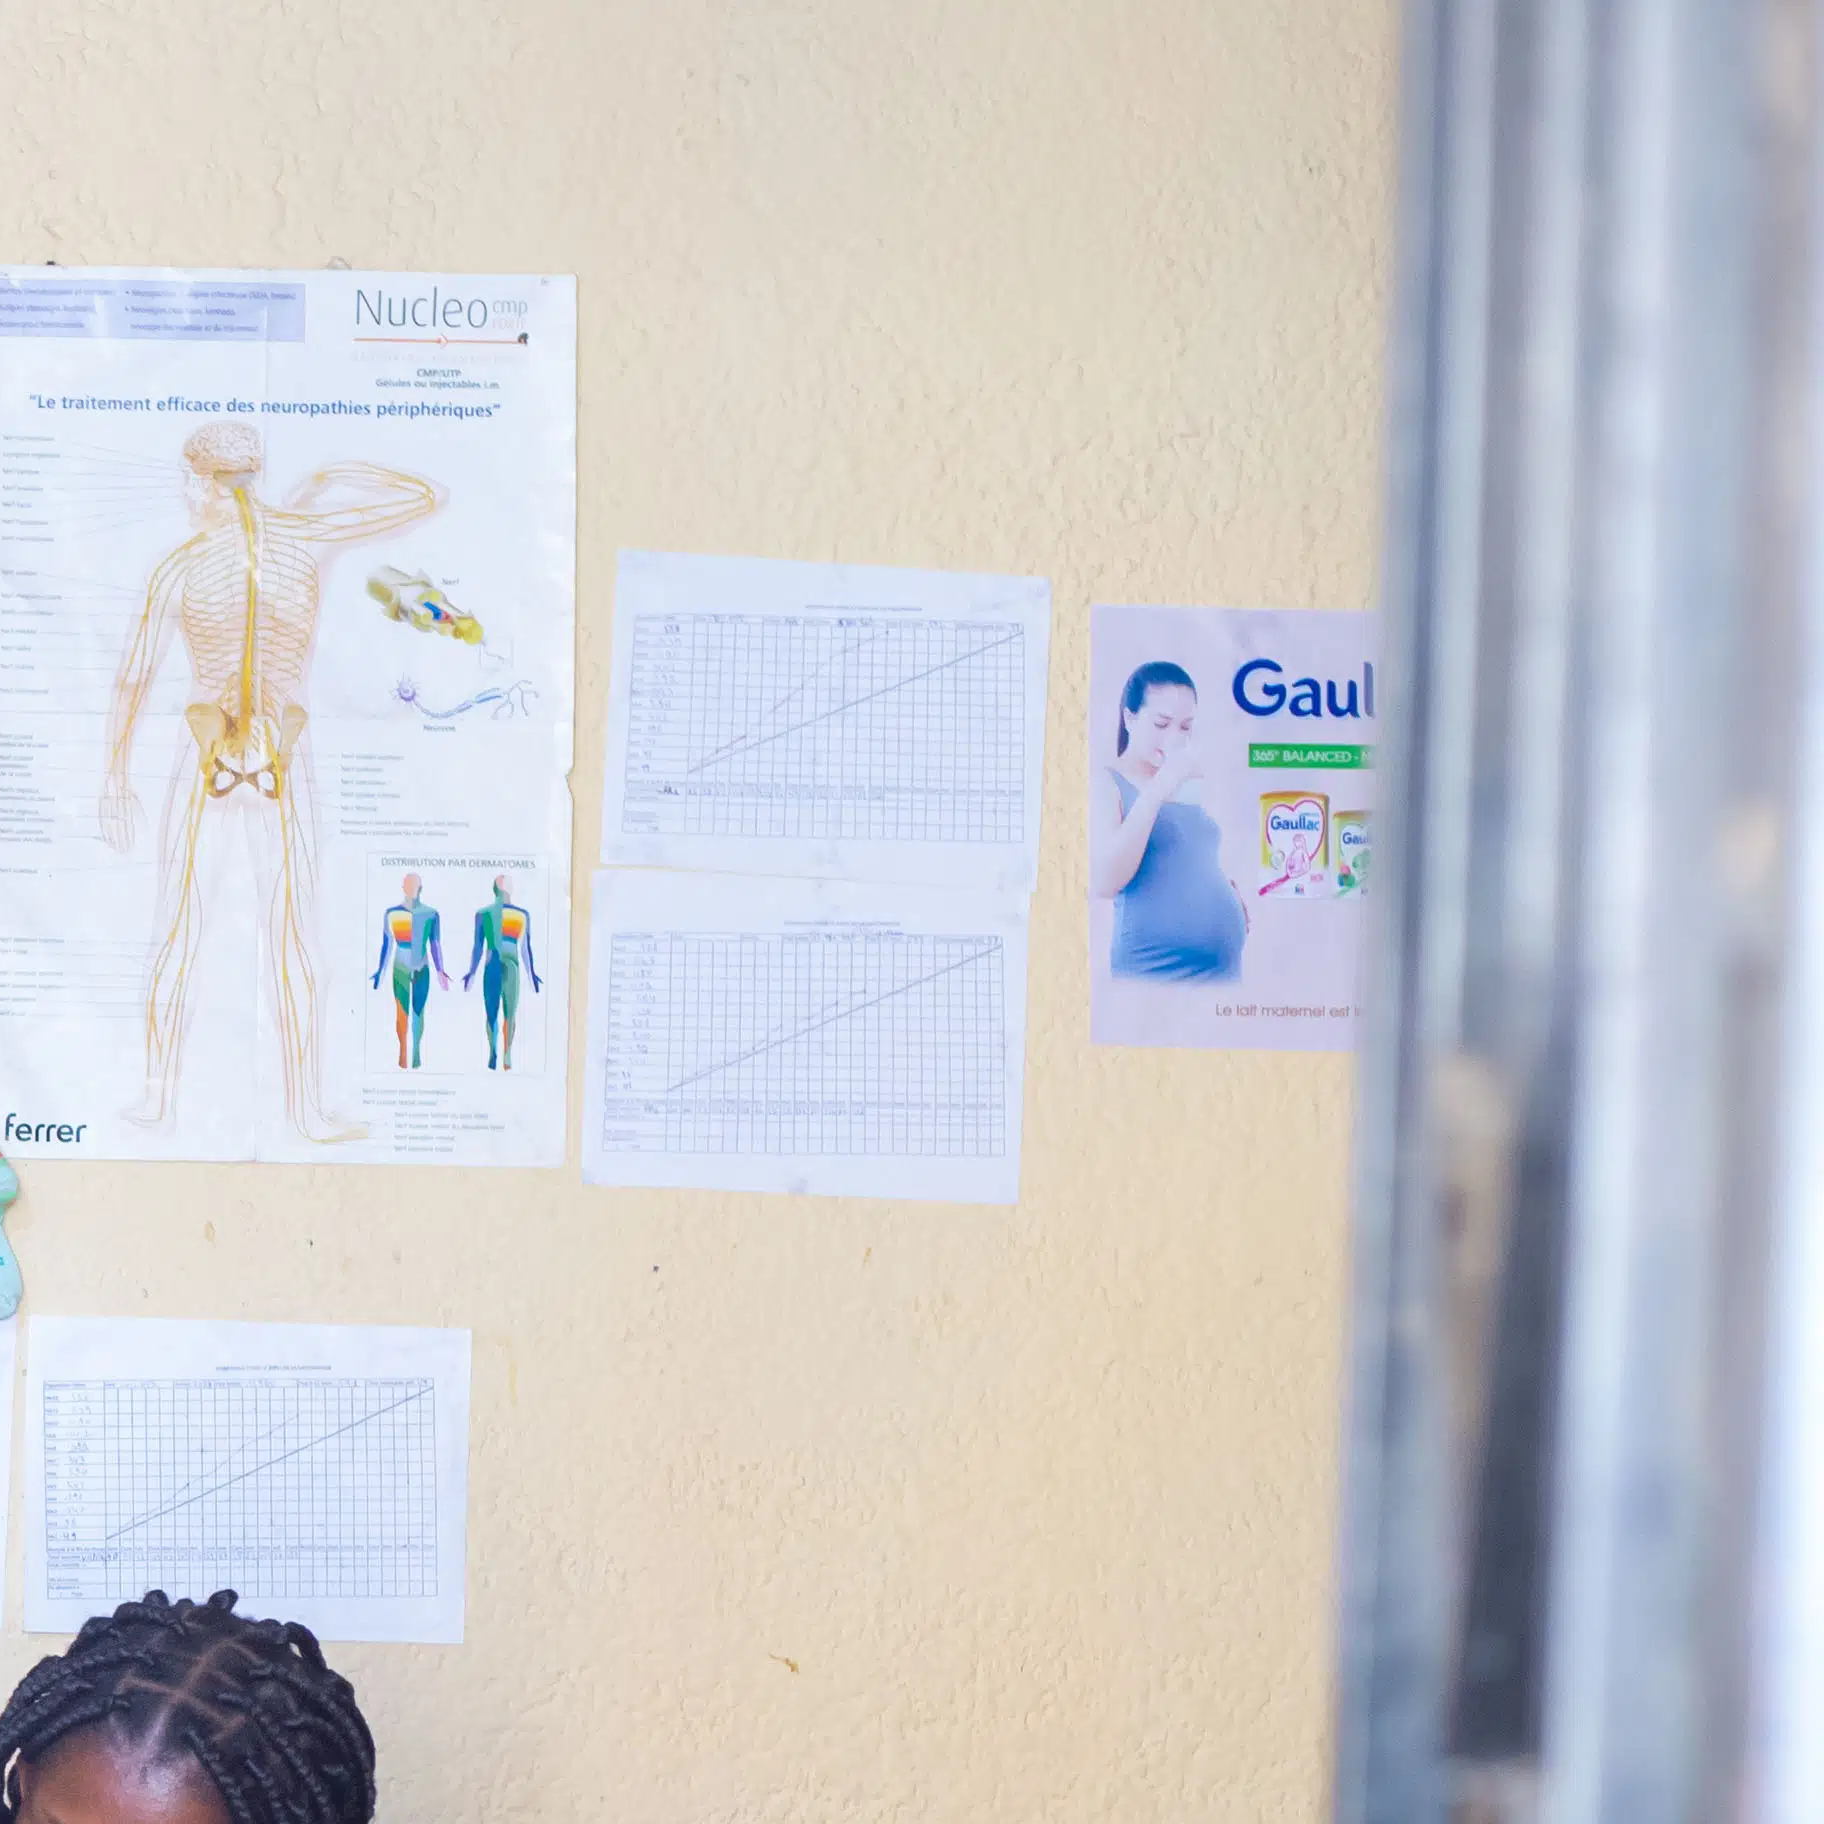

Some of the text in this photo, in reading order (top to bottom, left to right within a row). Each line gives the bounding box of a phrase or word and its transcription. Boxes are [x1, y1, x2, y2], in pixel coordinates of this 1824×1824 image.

[355, 285, 529, 329] Nucleo cmp
[61, 395, 152, 412] traitement
[156, 396, 222, 413] efficace
[226, 397, 256, 414] des
[260, 399, 371, 420] neuropathies
[1270, 815, 1320, 832] Gaullac
[381, 856, 446, 868] DISTRIBUTION
[1261, 1003, 1326, 1018] maternel
[4, 1113, 87, 1145] ferrer
